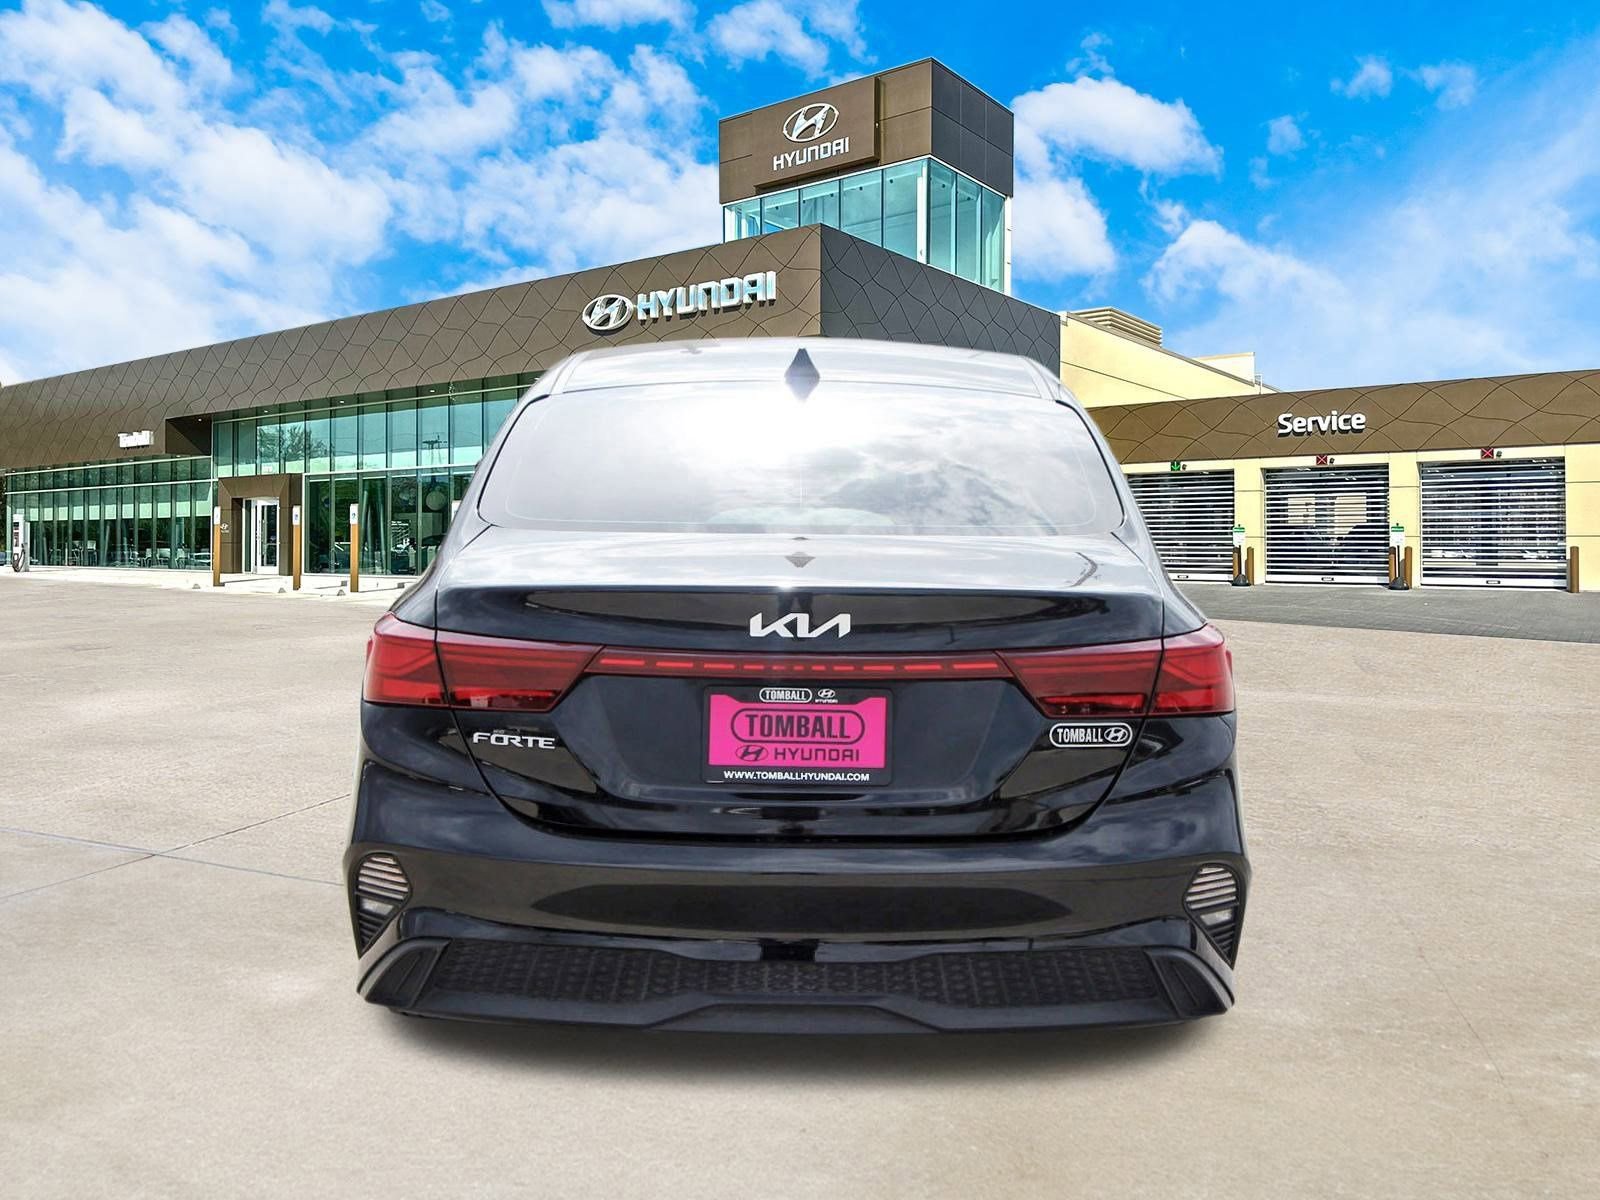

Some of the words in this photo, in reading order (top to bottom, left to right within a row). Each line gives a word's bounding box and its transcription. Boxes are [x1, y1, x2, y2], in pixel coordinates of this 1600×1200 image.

[772, 137, 850, 171] HYUNDAI
[637, 271, 777, 321] HYUNDAI
[1277, 410, 1367, 434] Service
[765, 690, 807, 701] TOMBALL
[745, 714, 851, 739] TOMBALL
[1056, 728, 1103, 743] TOMBALL
[472, 731, 556, 750] FORTE
[774, 748, 860, 762] HYUNDAI
[723, 770, 870, 782] WWW.TOMBALLHYUNDAI.COM
